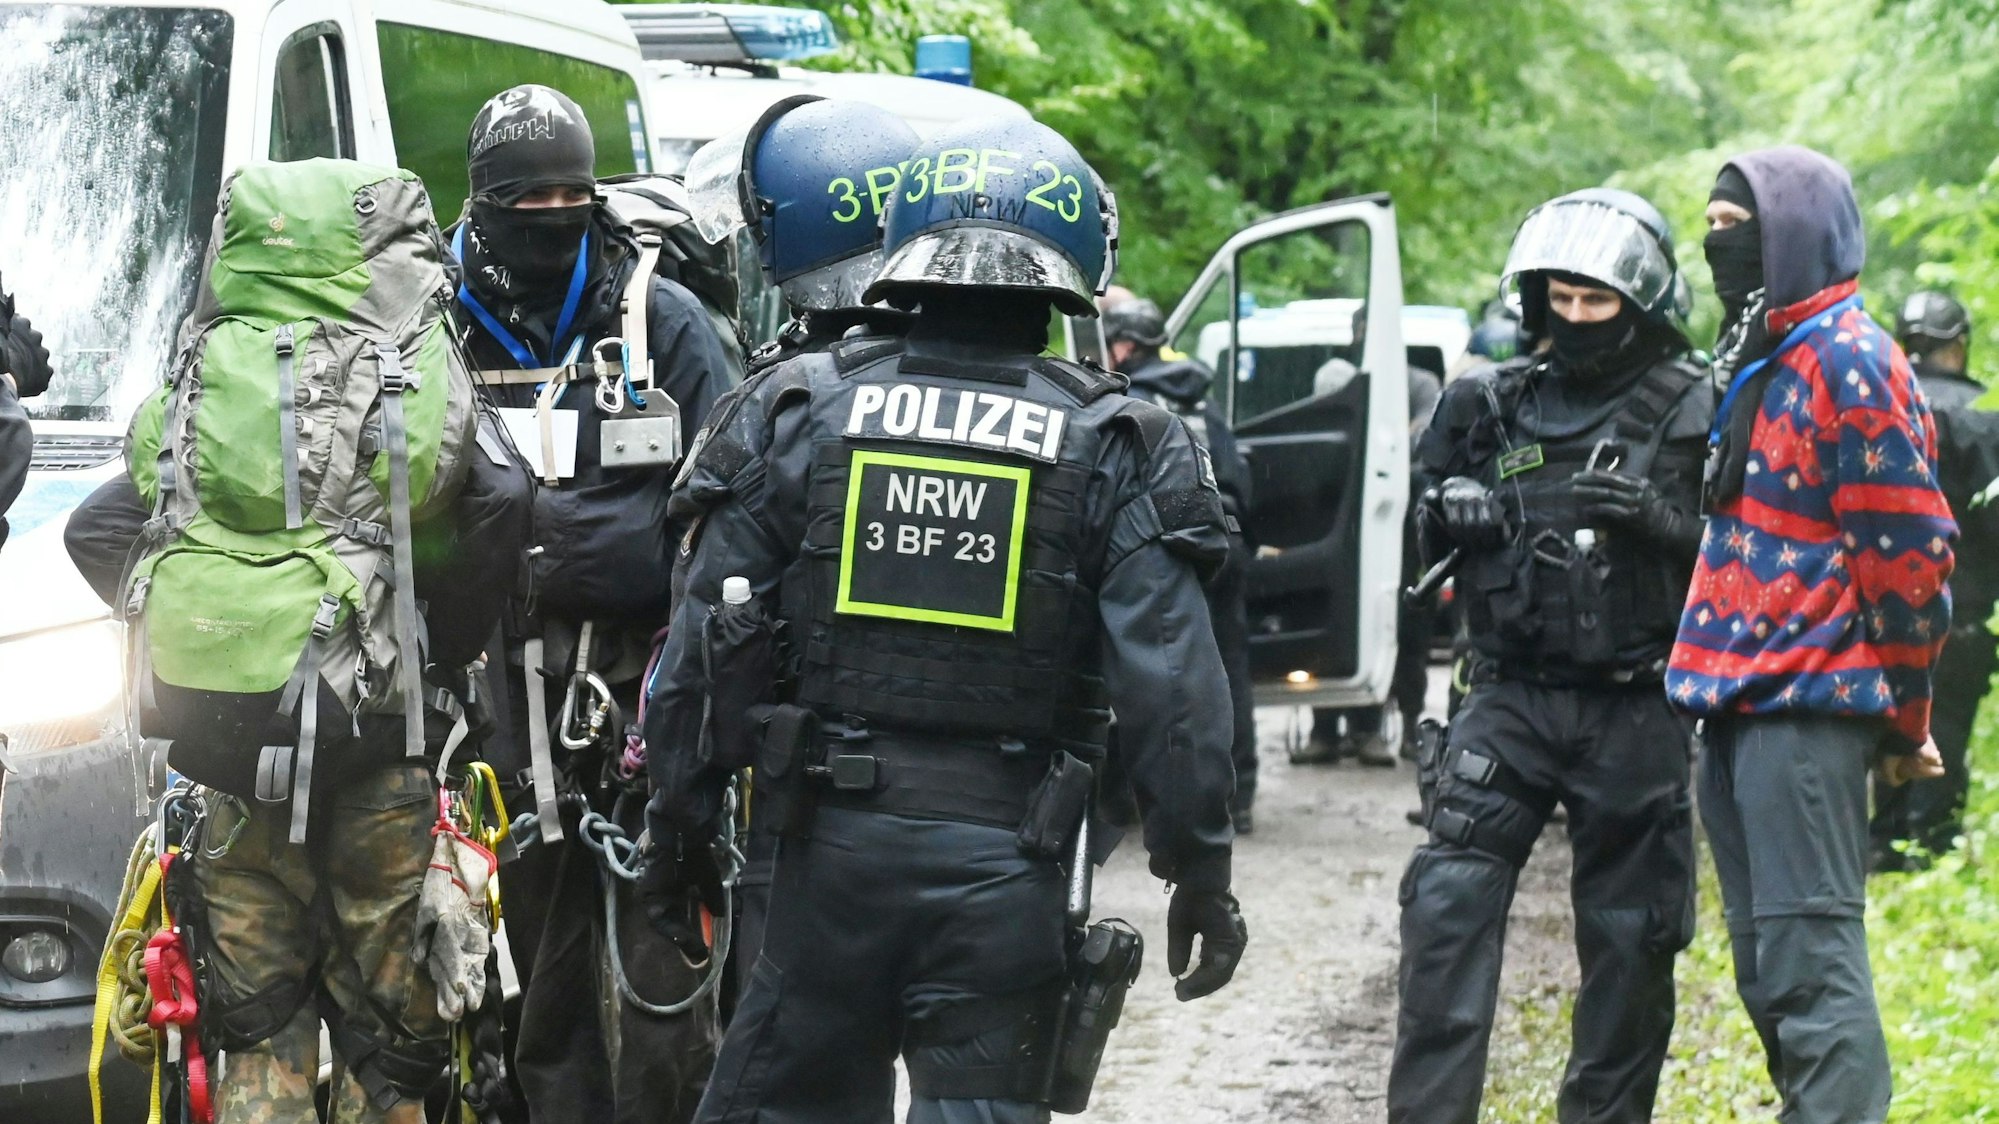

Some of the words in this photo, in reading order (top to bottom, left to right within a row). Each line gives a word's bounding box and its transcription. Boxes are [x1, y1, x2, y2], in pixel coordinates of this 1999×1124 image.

[950, 193, 1028, 224] NRW
[1025, 160, 1082, 222] 23
[262, 235, 295, 246] deuter
[847, 384, 1065, 460] POLIZEI
[886, 473, 987, 520] NRW
[865, 522, 885, 551] 3
[896, 524, 945, 556] BF
[954, 531, 996, 563] 23
